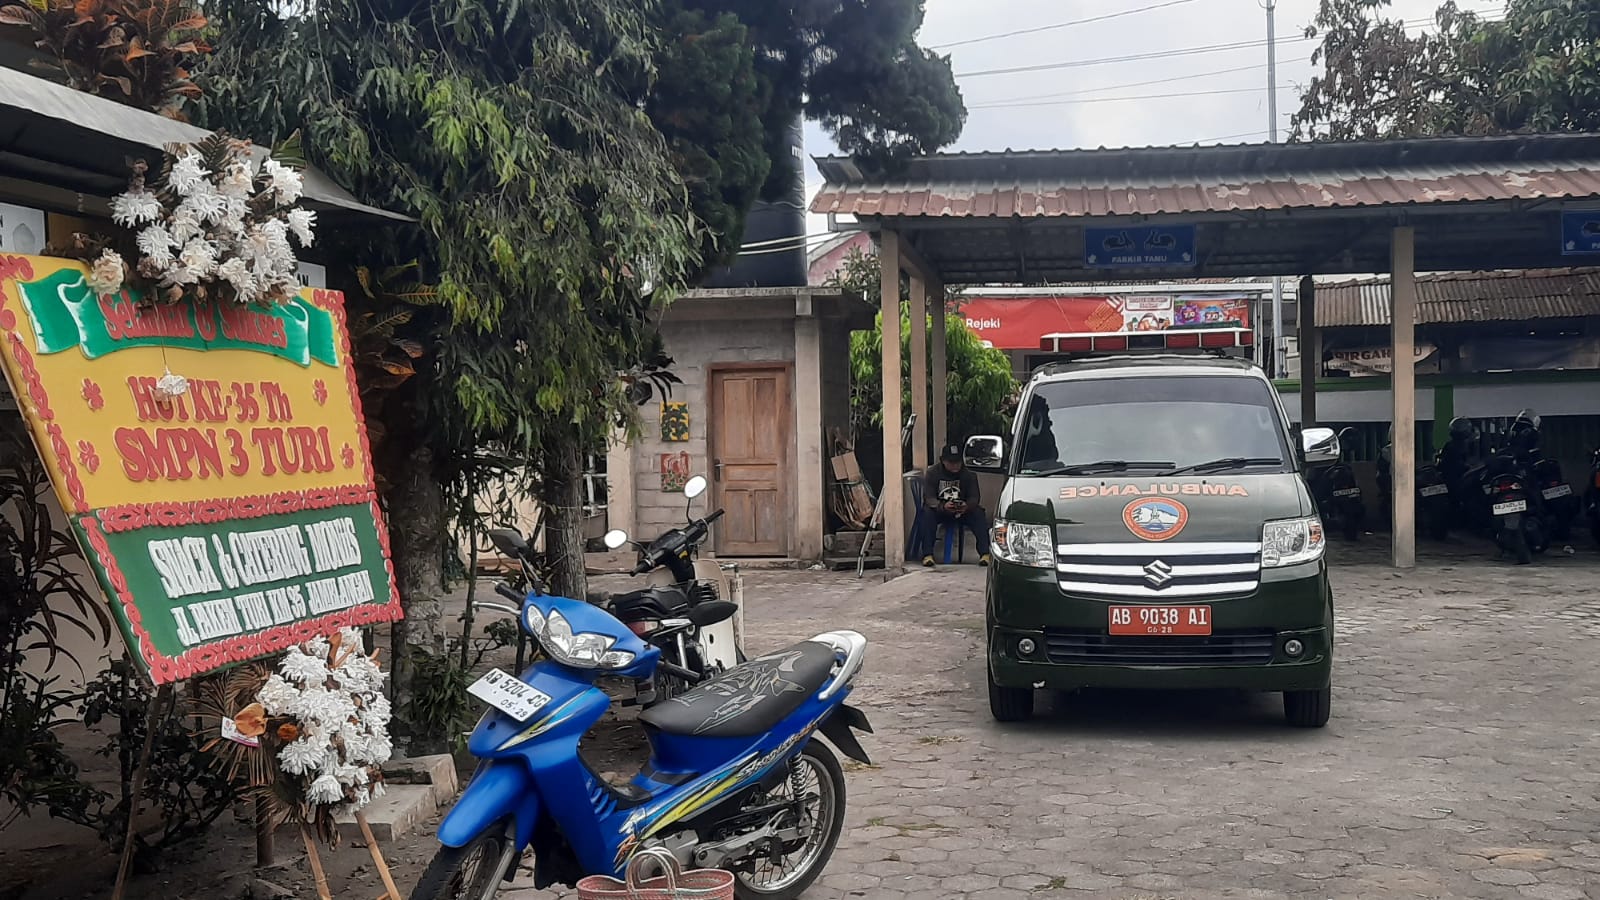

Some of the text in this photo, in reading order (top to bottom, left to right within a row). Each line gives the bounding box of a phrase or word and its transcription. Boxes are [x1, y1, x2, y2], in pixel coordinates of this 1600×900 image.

[1111, 255, 1142, 264] PARKIR
[966, 317, 1000, 330] Rejeki
[260, 380, 293, 423] Th
[114, 426, 335, 482] SMPN 3 TURI
[148, 536, 222, 599] SNACK
[212, 533, 240, 589] &
[228, 524, 312, 586] CATERING
[234, 591, 274, 631] TURI
[1112, 607, 1208, 625] AB 9038 AI
[484, 670, 503, 684] AB
[499, 678, 529, 698] 5204
